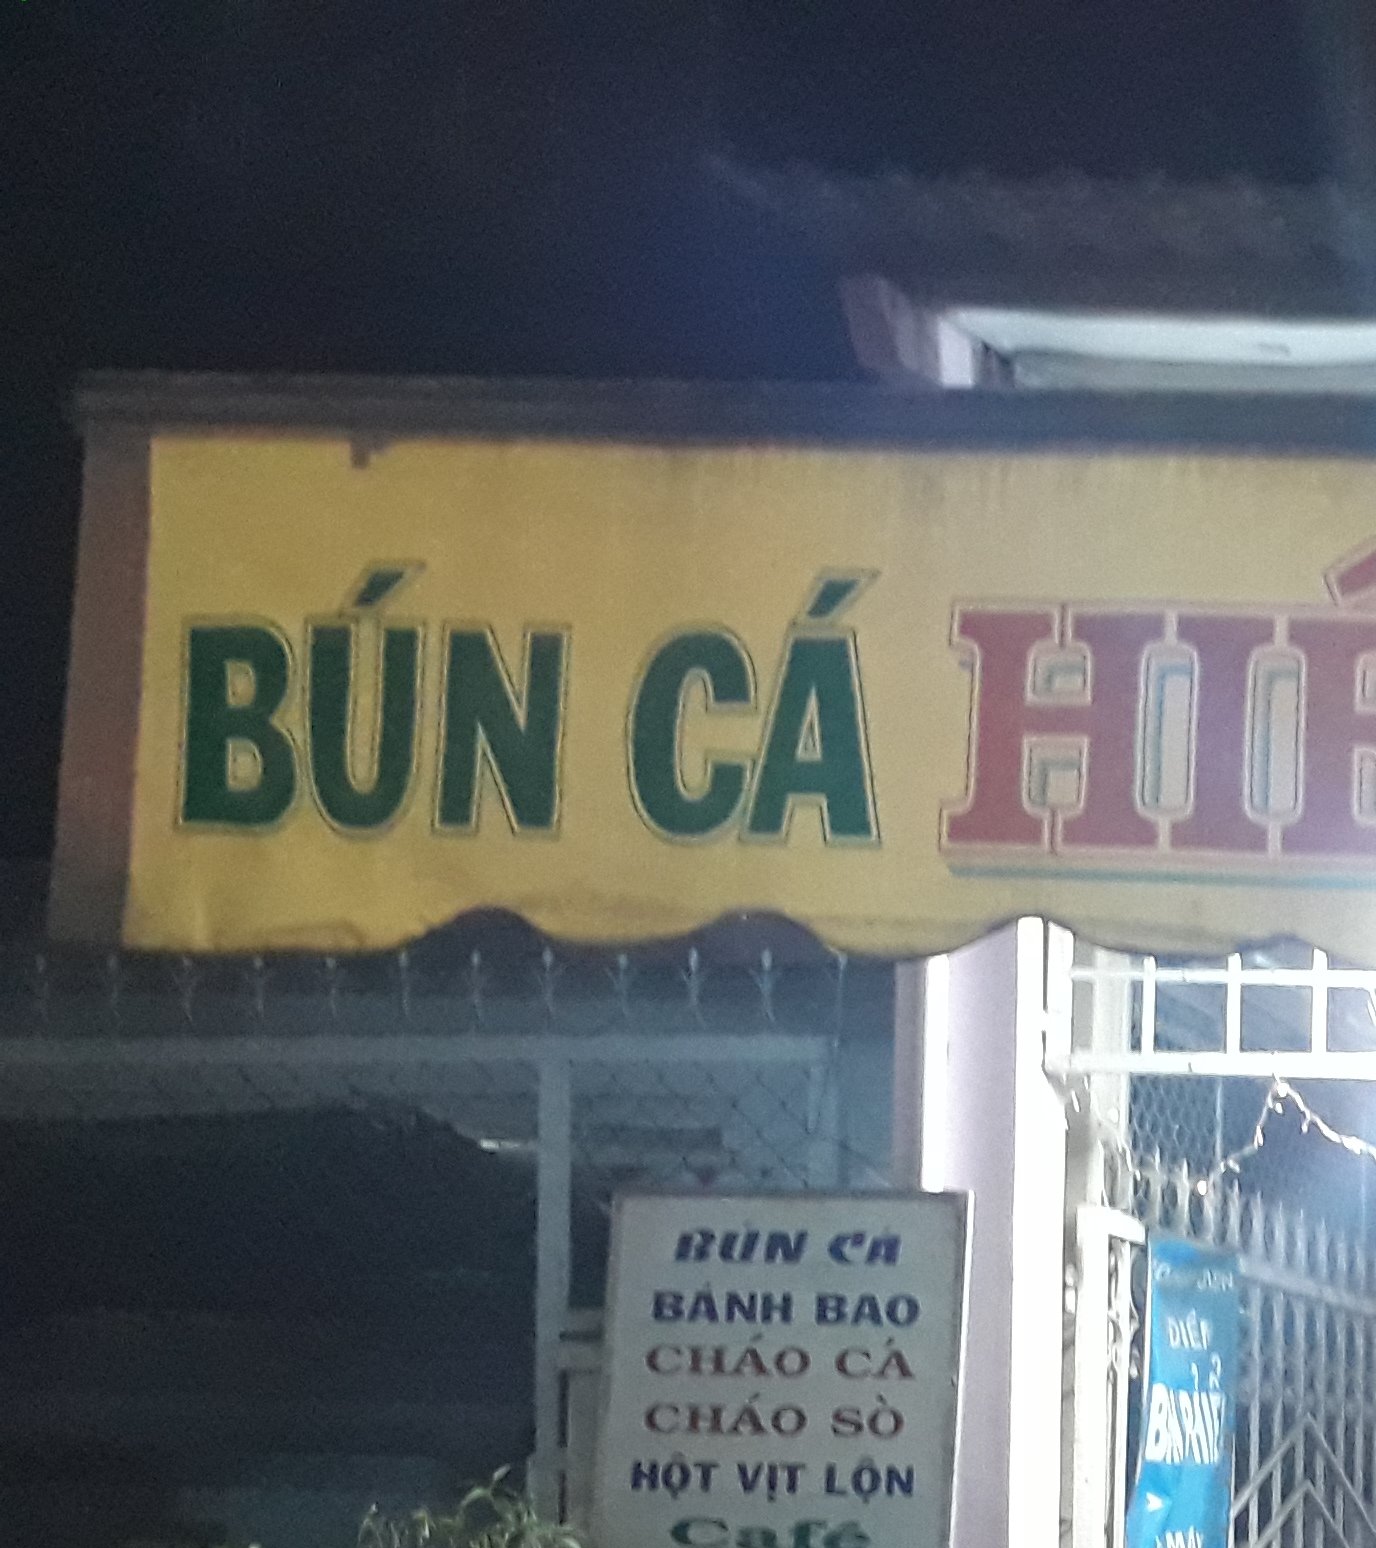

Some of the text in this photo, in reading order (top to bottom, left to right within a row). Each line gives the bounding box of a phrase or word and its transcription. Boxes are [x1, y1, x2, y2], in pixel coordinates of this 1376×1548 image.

[176, 563, 570, 834] BÚN
[626, 569, 882, 843] CÁ
[814, 1292, 920, 1328] BAO
[645, 1332, 915, 1380] CHÁO CÁ
[644, 1391, 905, 1438] CHÁO SÒ
[630, 1451, 915, 1505] HỘT VỊT LỘN
